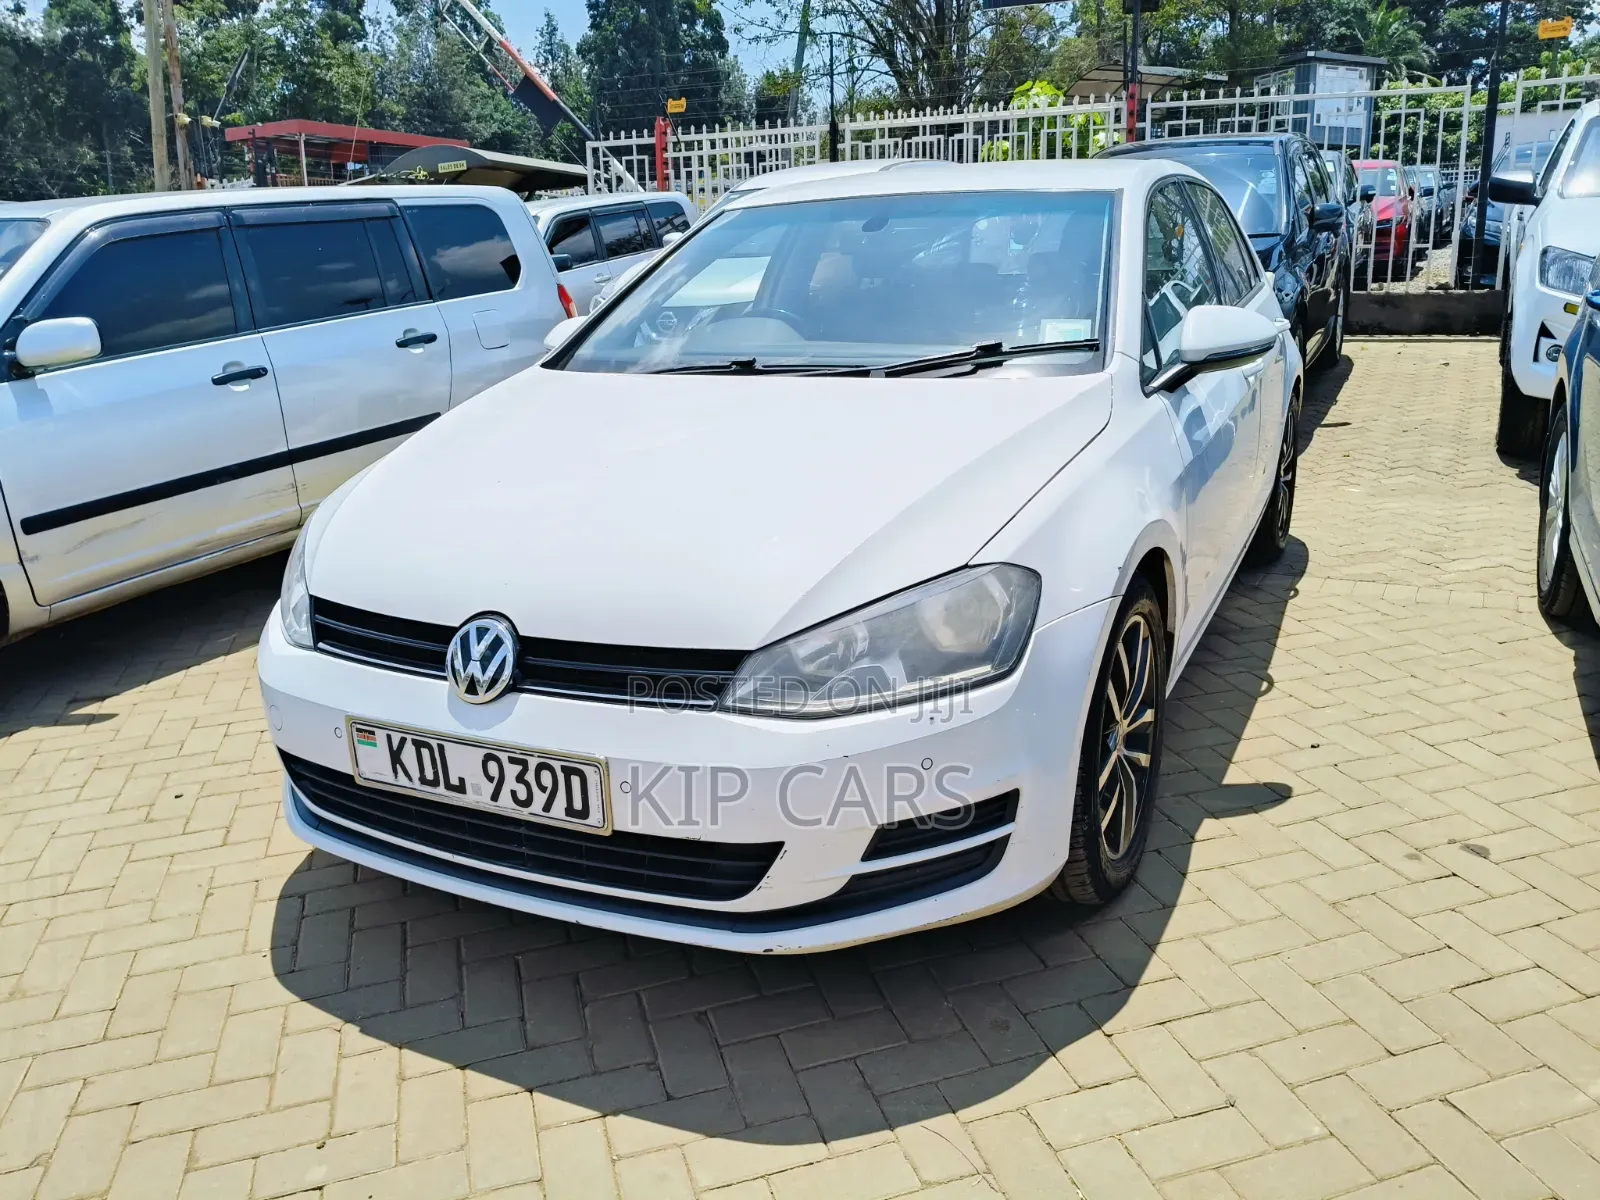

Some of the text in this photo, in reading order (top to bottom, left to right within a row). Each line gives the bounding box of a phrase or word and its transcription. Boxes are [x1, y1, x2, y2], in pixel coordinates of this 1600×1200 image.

[448, 620, 512, 702] VW
[386, 733, 467, 795] KDL
[481, 752, 591, 820] 939D
